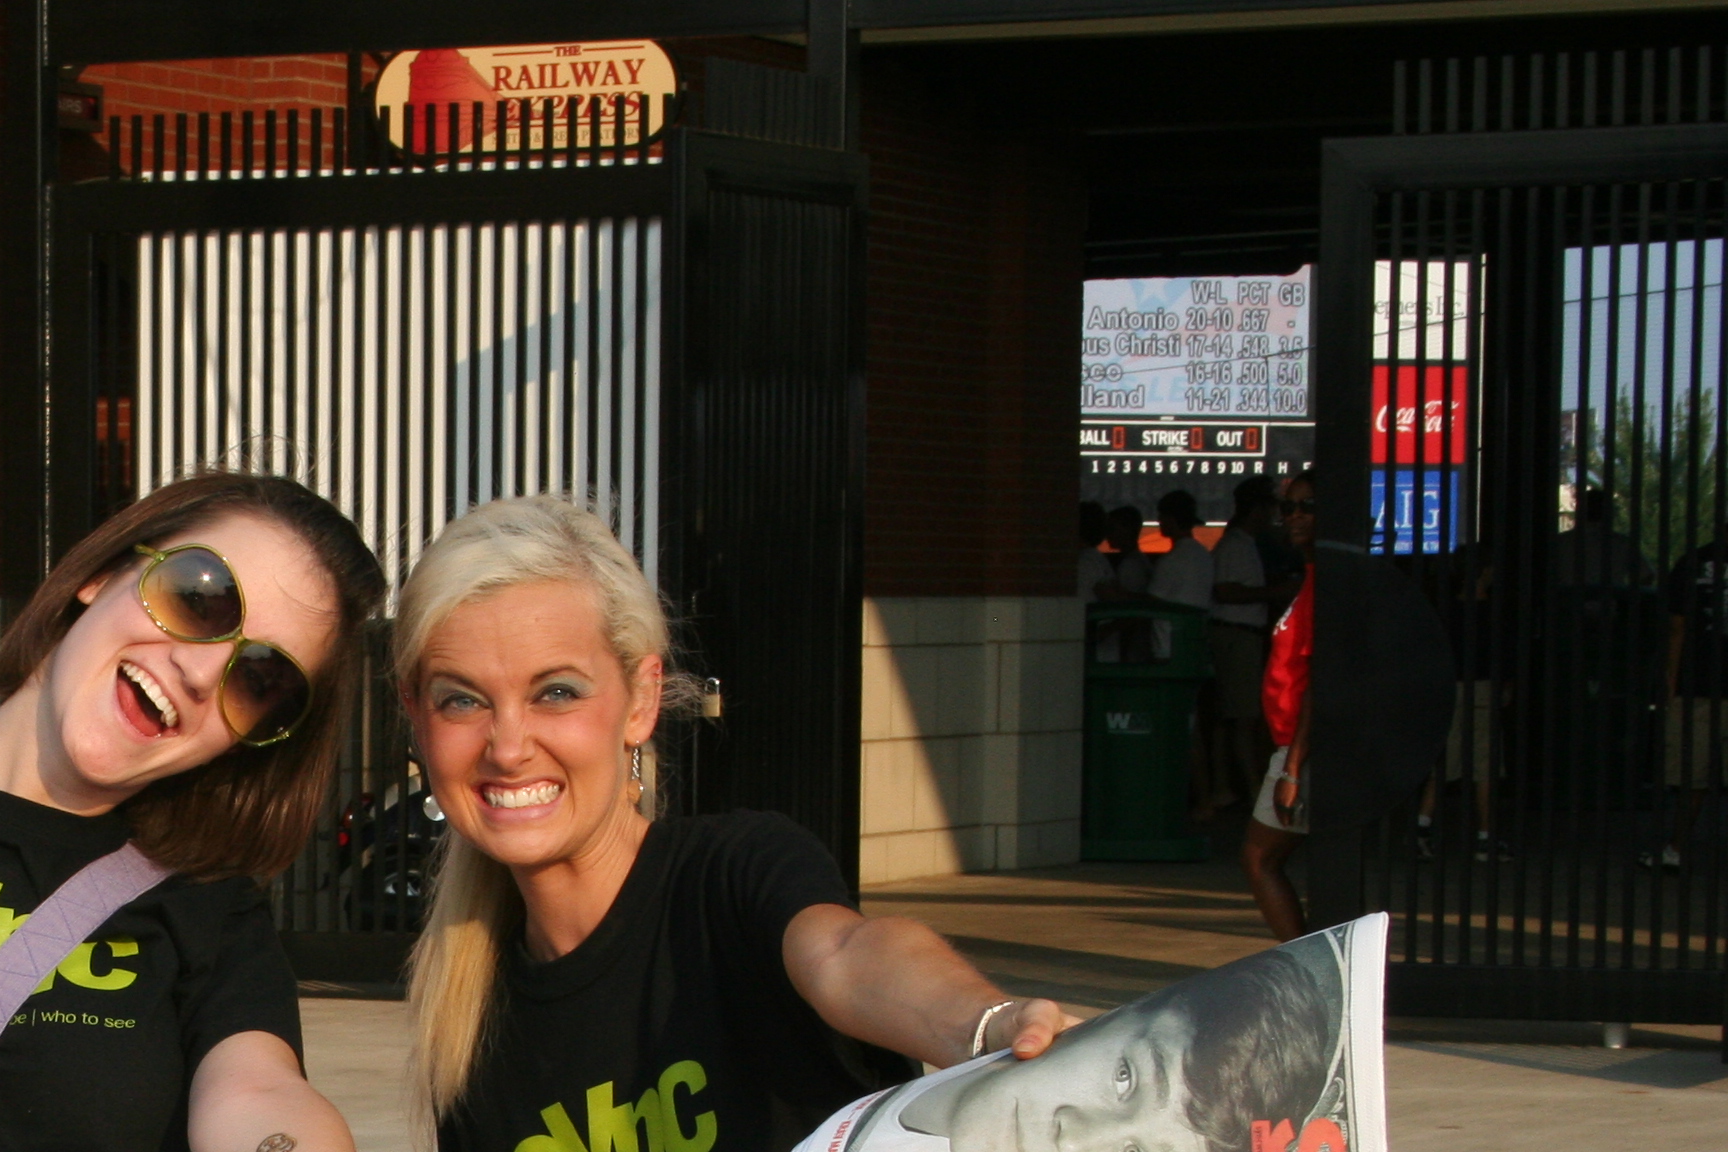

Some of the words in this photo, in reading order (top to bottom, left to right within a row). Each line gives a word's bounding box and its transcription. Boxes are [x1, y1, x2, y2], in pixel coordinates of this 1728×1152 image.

[554, 45, 582, 57] THE
[491, 58, 646, 91] RAILWAY
[1191, 280, 1228, 304] W-L
[1237, 282, 1271, 305] PCT
[1278, 283, 1305, 306] GB
[1087, 306, 1179, 331] Antonio
[1185, 308, 1233, 331] 20-10
[1238, 309, 1269, 331] .667
[1115, 333, 1181, 356] Christi
[1186, 335, 1233, 358] 17-14
[1237, 336, 1269, 358] .548
[1279, 336, 1303, 358] 3.5
[1186, 363, 1232, 385] 16-16
[1236, 363, 1268, 385] .500
[1277, 363, 1302, 385] 5.0
[1185, 388, 1231, 411] 11-21
[1236, 388, 1268, 411] .344
[1274, 388, 1307, 412] 10.0
[1142, 430, 1189, 446] STRIKE
[1217, 430, 1243, 446] OUT
[1092, 460, 1099, 473] 1
[1107, 461, 1116, 473] 2
[1122, 461, 1131, 473] 3
[1138, 461, 1147, 473] 4
[1154, 461, 1163, 473] 5
[1169, 461, 1179, 473] 6
[1186, 461, 1195, 473] 7
[1201, 461, 1210, 473] 8
[1217, 462, 1226, 474] 9
[1231, 462, 1244, 474] 10
[1254, 462, 1263, 474] R
[1278, 462, 1288, 474] H
[41, 1010, 77, 1025] who
[81, 1012, 99, 1026] to
[104, 1016, 136, 1029] see
